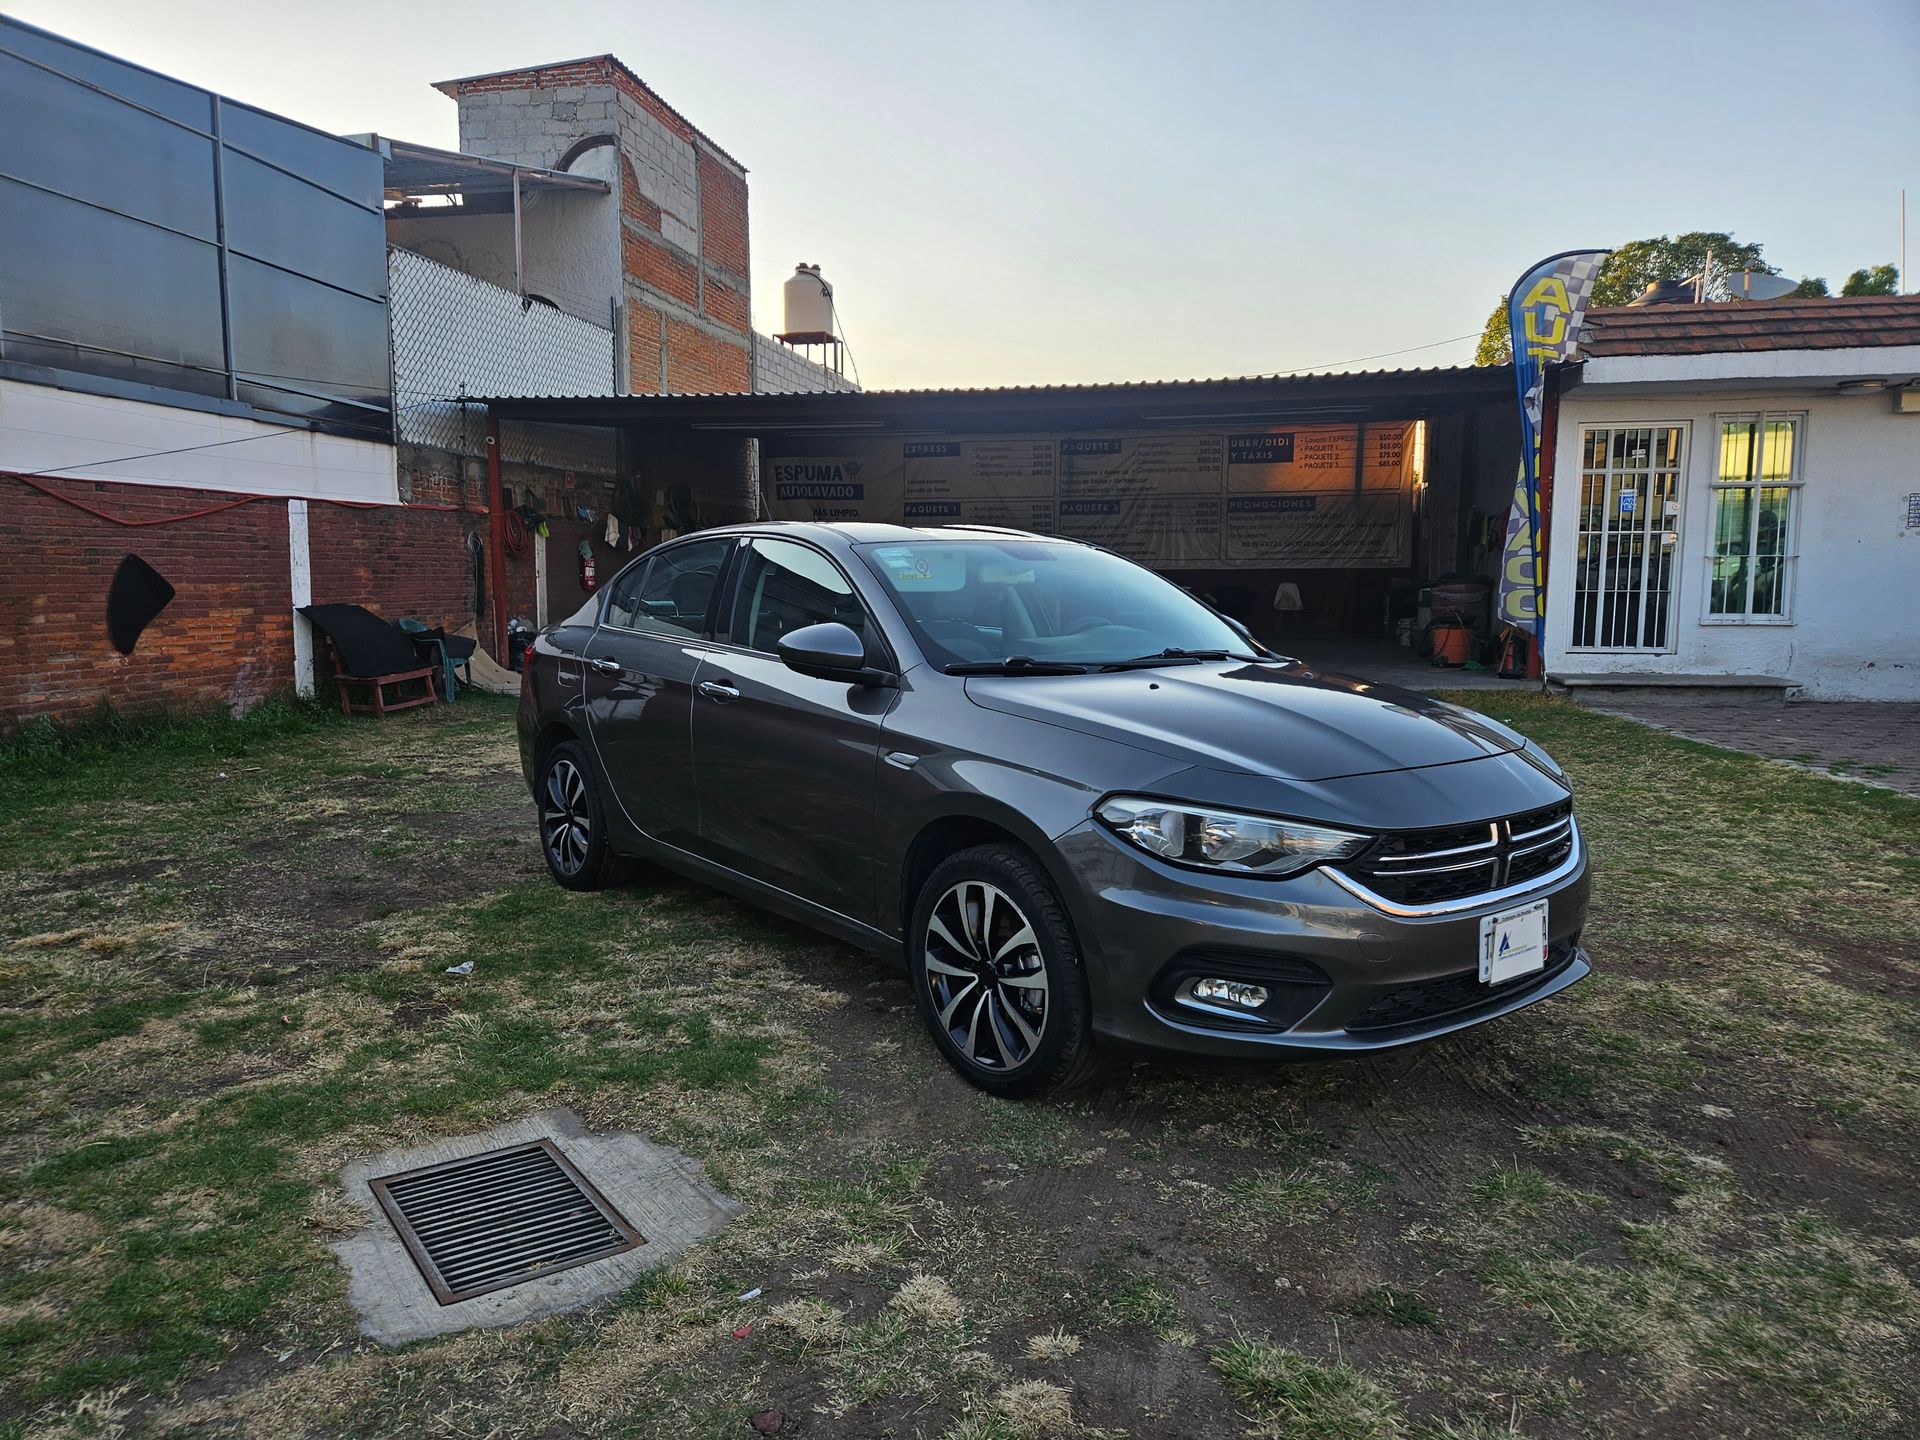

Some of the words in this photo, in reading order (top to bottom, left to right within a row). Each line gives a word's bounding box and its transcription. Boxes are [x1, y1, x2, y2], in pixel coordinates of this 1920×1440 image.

[1063, 442, 1110, 450] PAQUETE
[1231, 437, 1289, 449] UBER/DIDI
[905, 444, 948, 454] EXPRESS
[1242, 452, 1274, 460] TAXIS
[1304, 453, 1332, 461] PAQUETE
[1304, 462, 1333, 470] PAQUETE
[1379, 460, 1401, 468] $85.00
[775, 463, 844, 482] ESPUMA
[780, 485, 855, 498] AUTOLAVADO
[1062, 504, 1109, 512] PAQUETE
[1230, 499, 1311, 509] PROMOCIONES
[905, 506, 950, 514] PAQUETE
